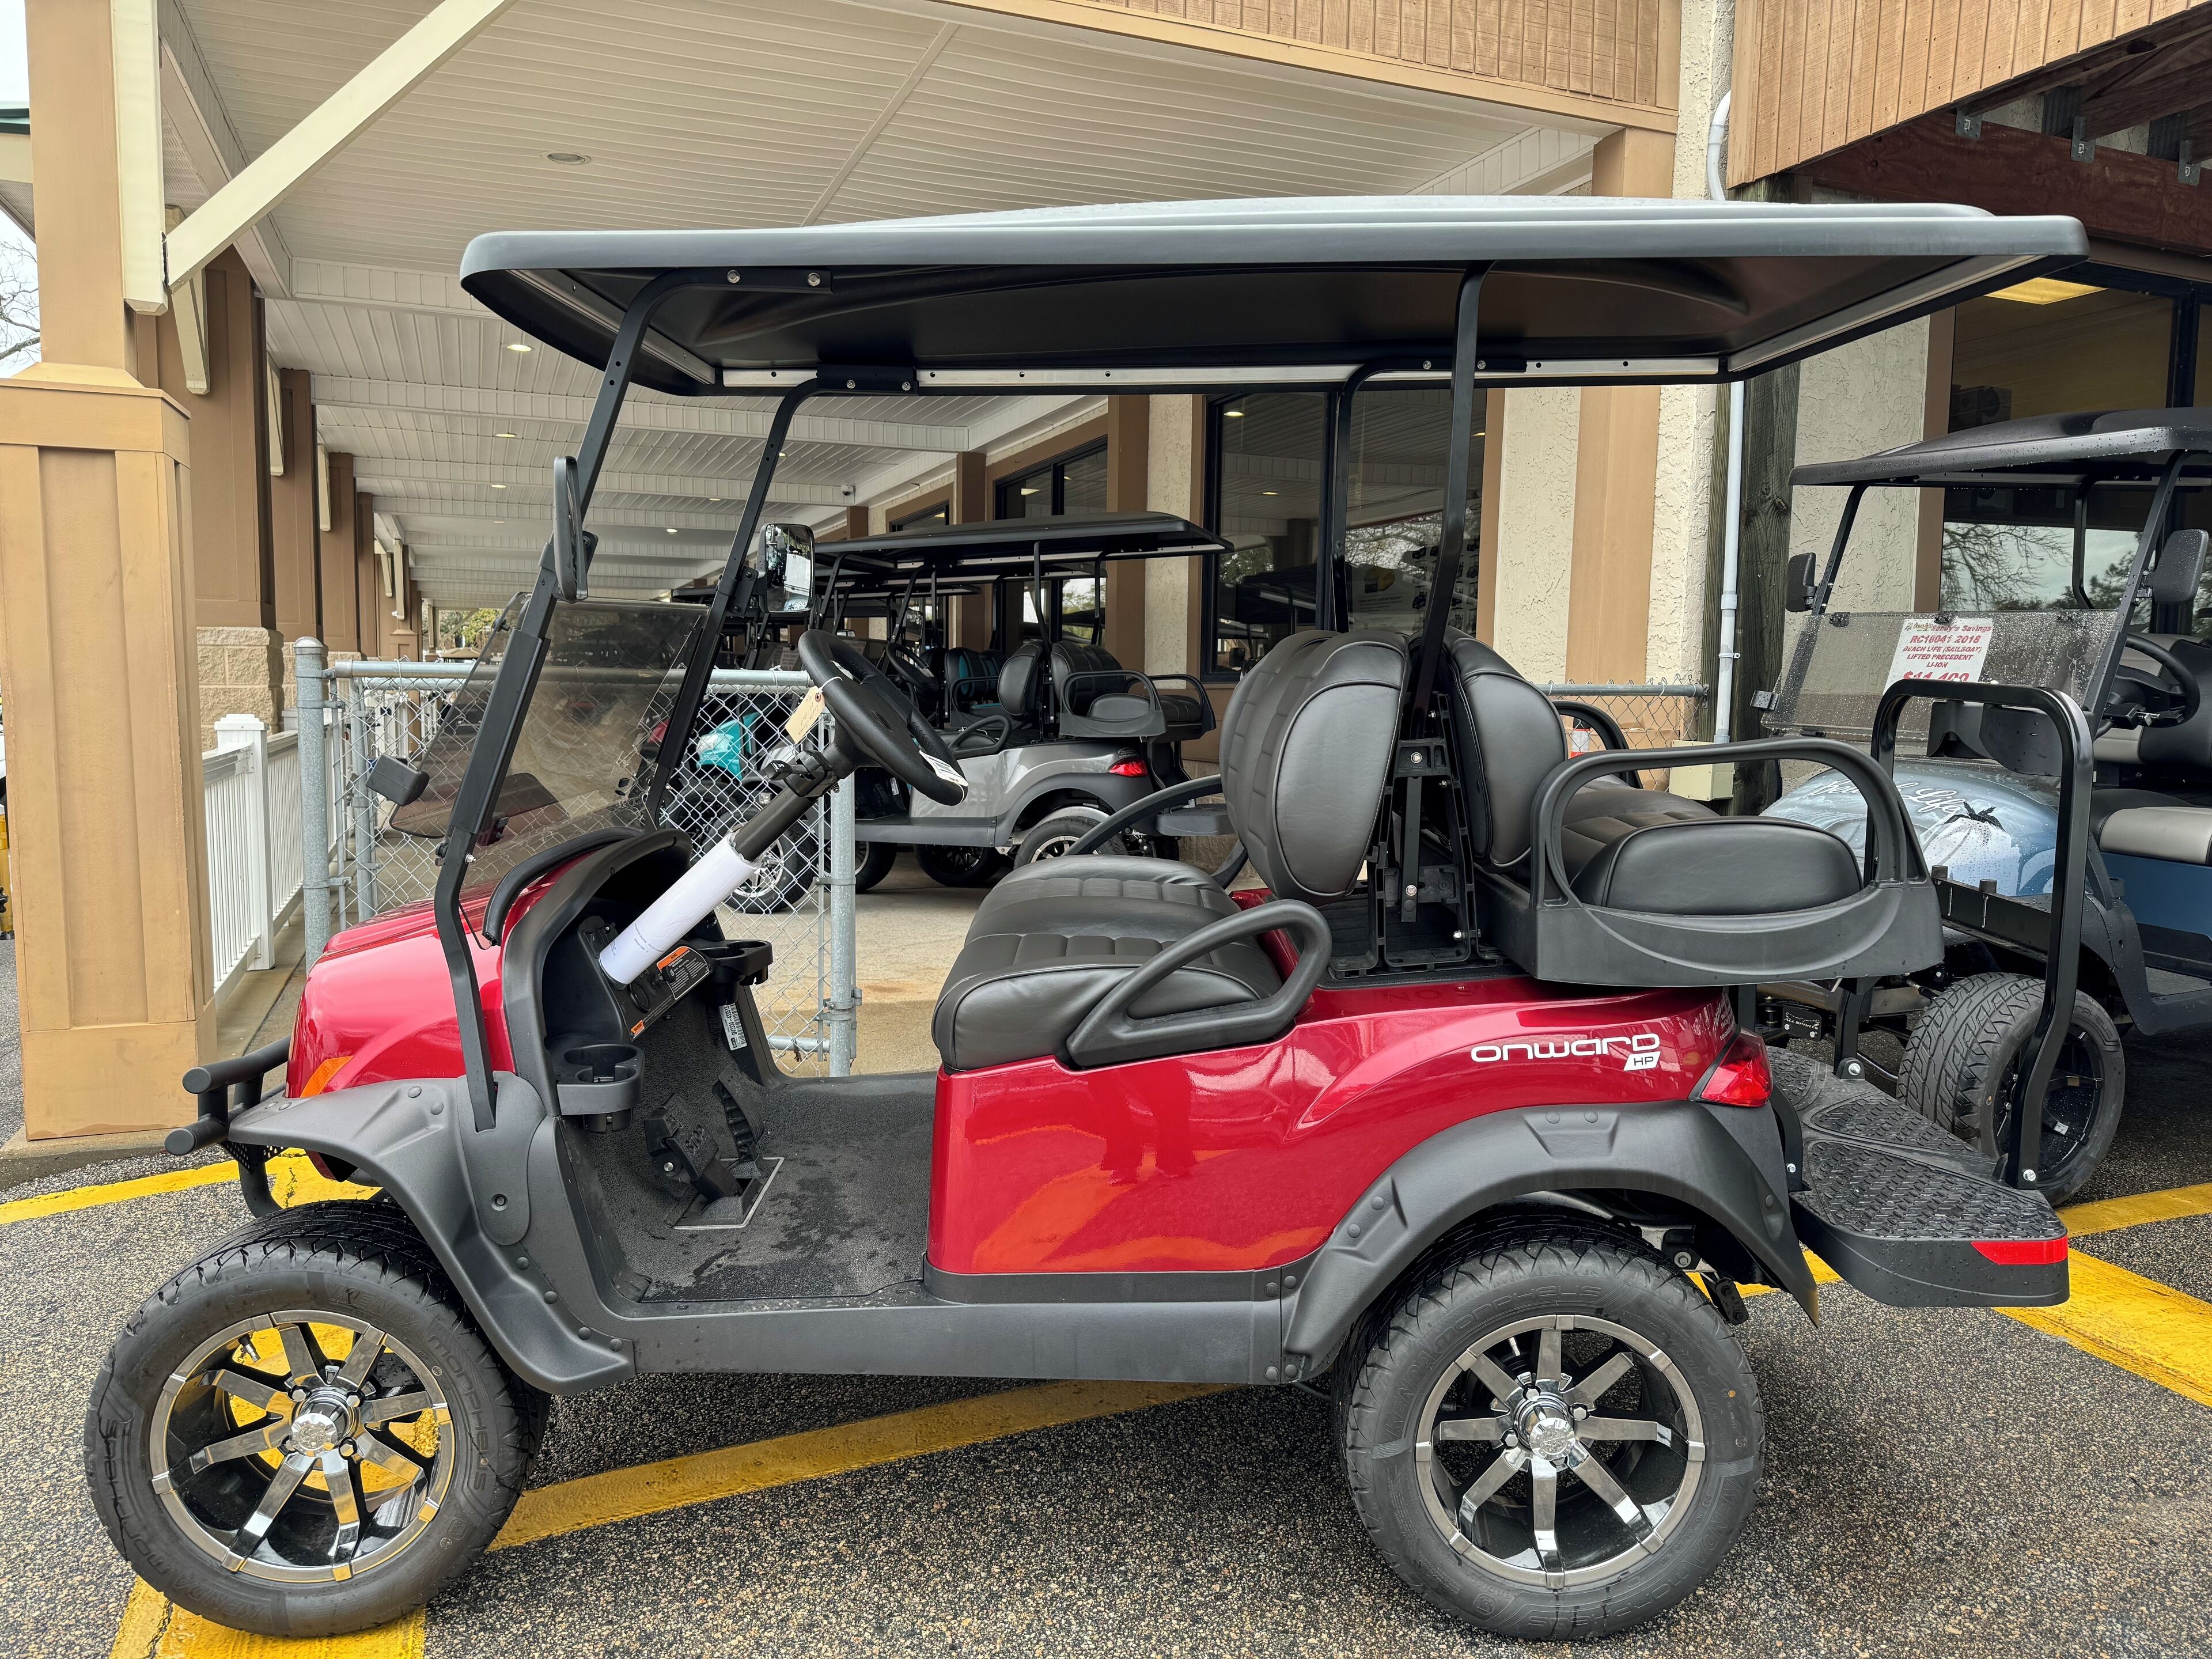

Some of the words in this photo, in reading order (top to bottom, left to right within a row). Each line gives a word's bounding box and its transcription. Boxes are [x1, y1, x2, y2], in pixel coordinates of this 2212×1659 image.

[1954, 635, 1982, 643] 2018
[1903, 786, 1965, 813] Life
[1796, 1021, 1819, 1030] SPORTS
[1634, 1056, 1654, 1066] HP
[1383, 1351, 1436, 1439] KENDA
